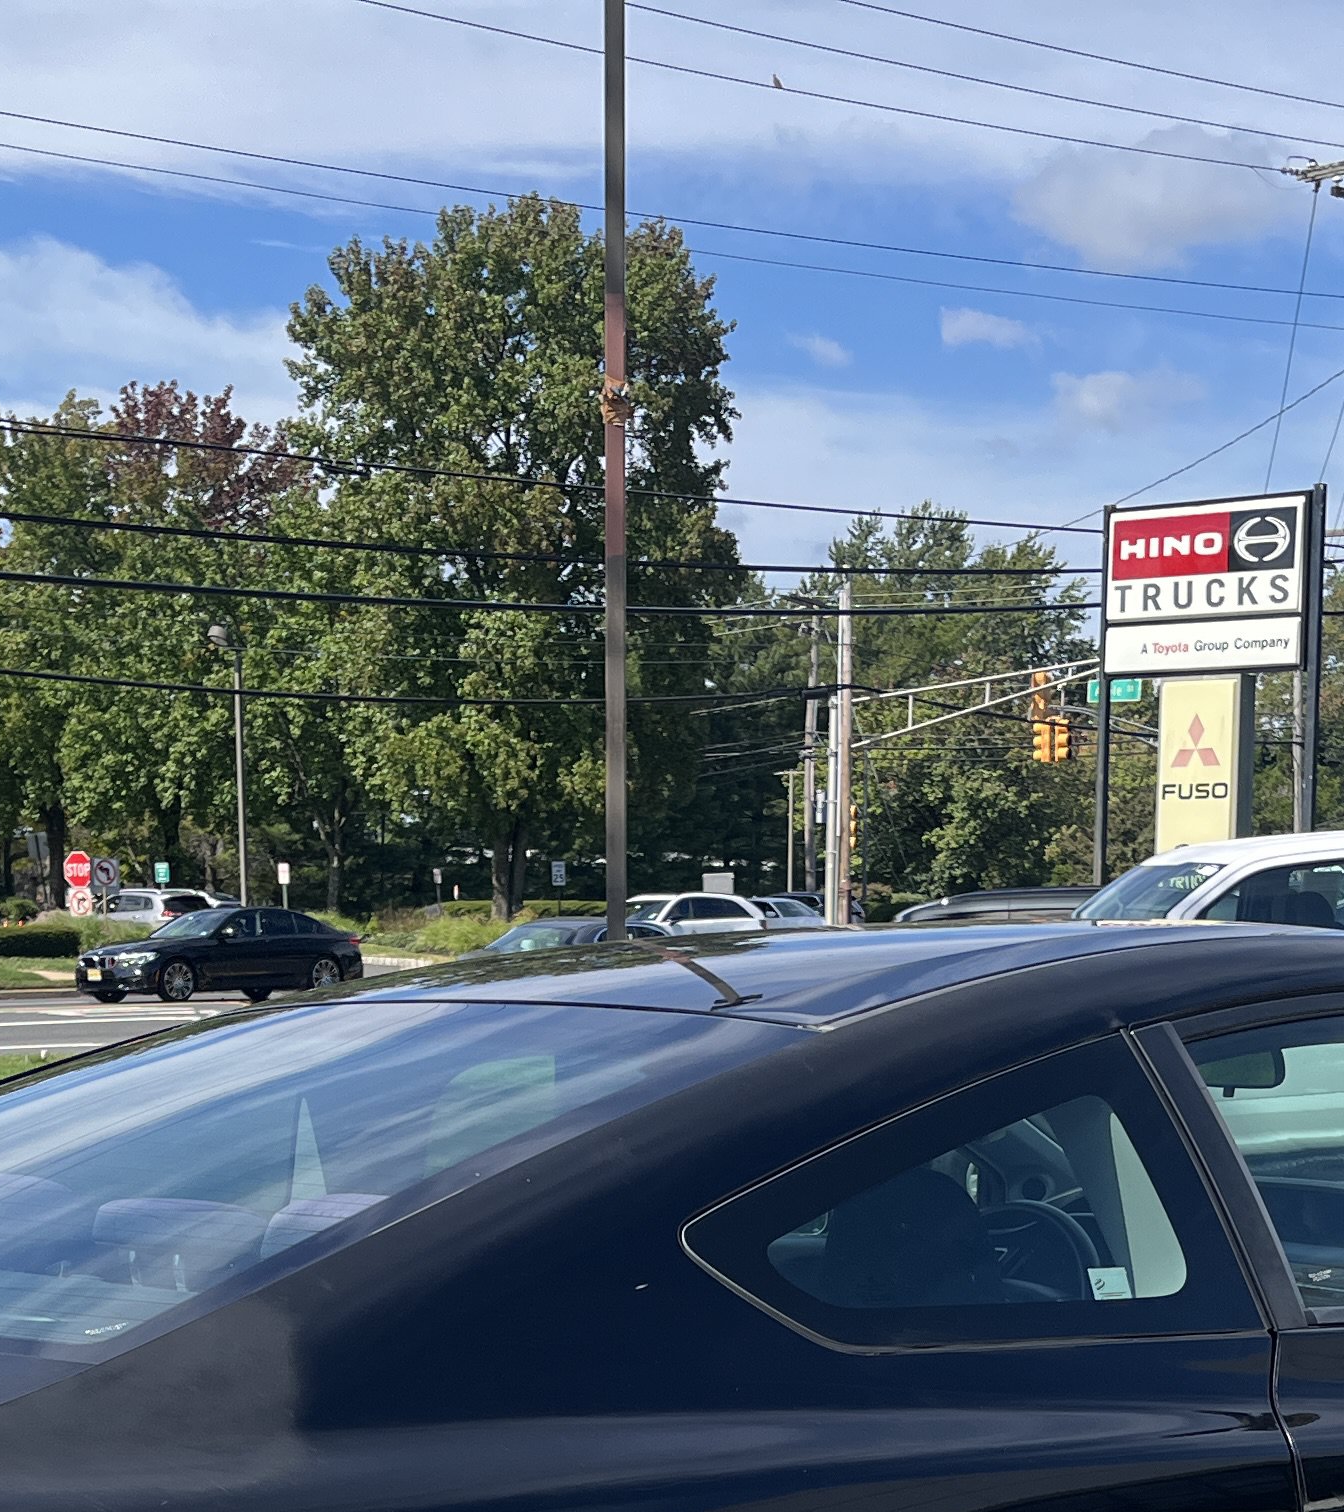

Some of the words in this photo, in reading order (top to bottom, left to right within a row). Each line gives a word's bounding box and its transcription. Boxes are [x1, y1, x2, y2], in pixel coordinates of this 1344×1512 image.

[1119, 531, 1224, 561] HINO
[1114, 574, 1290, 613] TRUCKS
[1140, 643, 1149, 655] A
[1152, 642, 1189, 656] Toyota
[1194, 640, 1229, 653] Group
[1234, 637, 1290, 650] Company
[1161, 782, 1228, 801] FUSO
[65, 862, 91, 878] STOP
